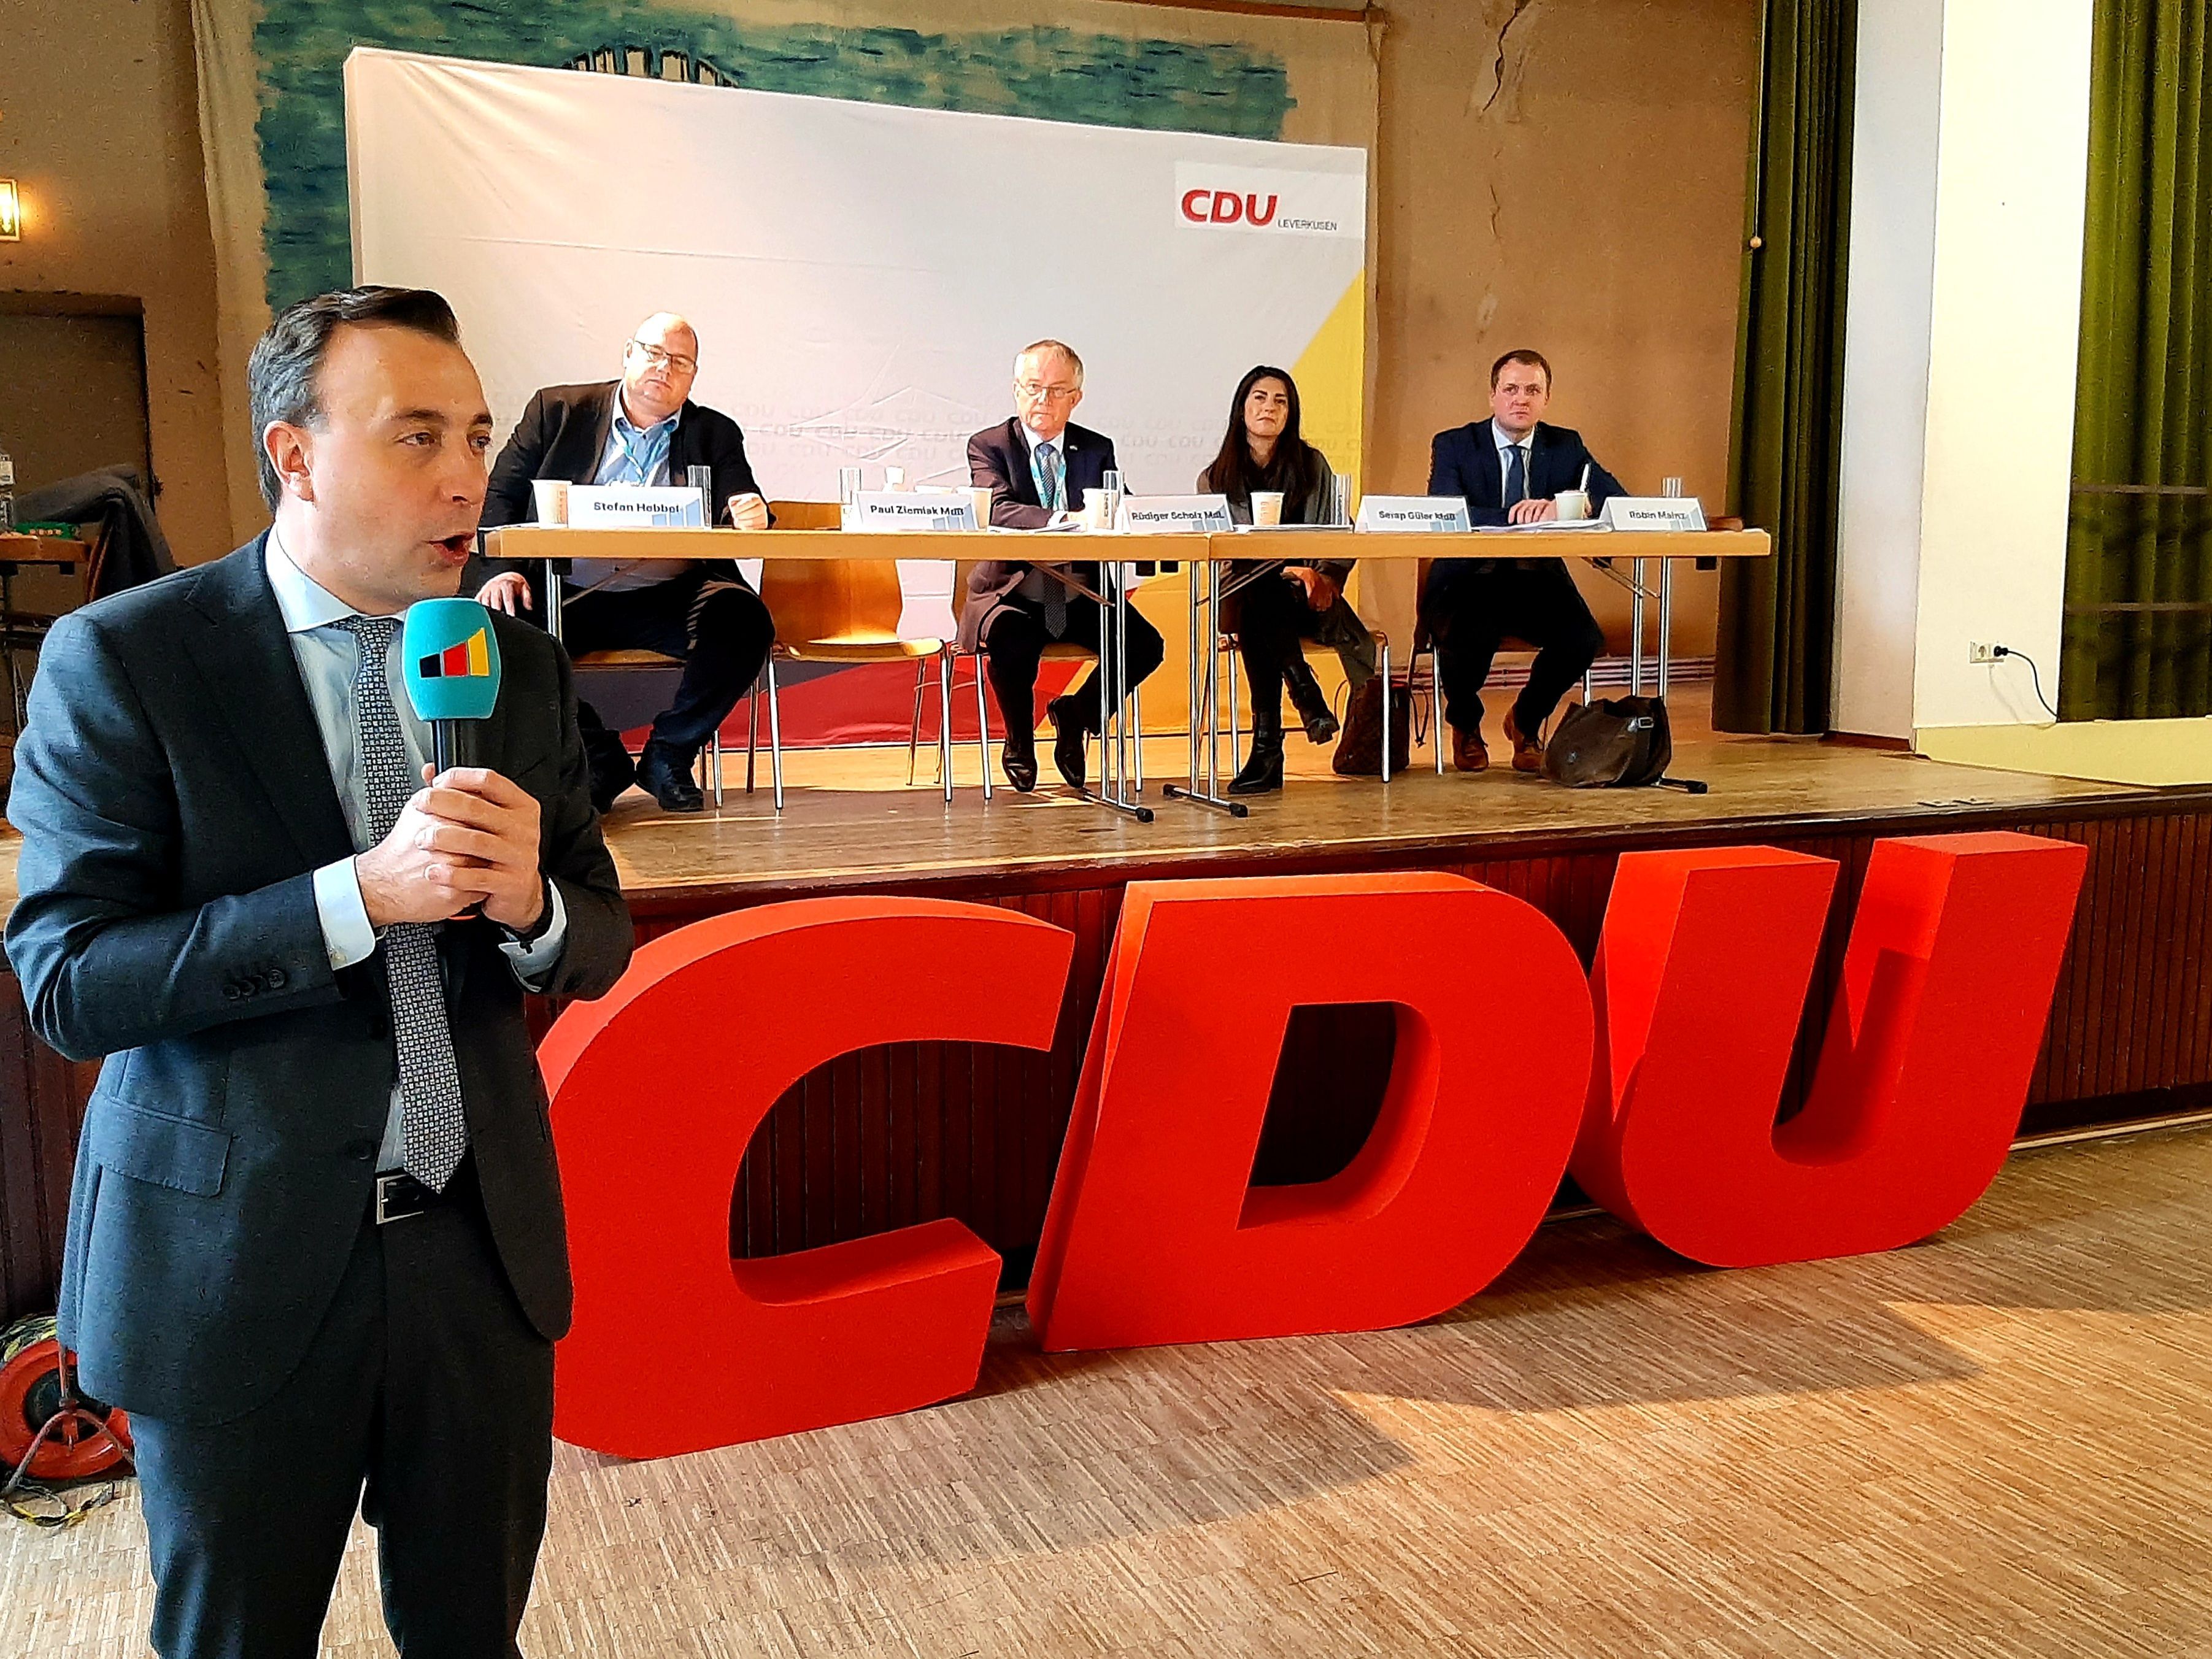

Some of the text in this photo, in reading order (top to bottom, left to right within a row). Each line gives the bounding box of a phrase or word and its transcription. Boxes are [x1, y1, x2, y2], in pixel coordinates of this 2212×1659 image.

[1181, 188, 1338, 231] CDU LEVERKUSEN
[593, 502, 680, 513] Stefan Hebbel
[870, 504, 895, 515] Paul
[896, 505, 939, 515] Ziemiak
[1171, 511, 1203, 520] Scholz
[1408, 511, 1433, 520] Güler
[536, 830, 2087, 1461] CDU
